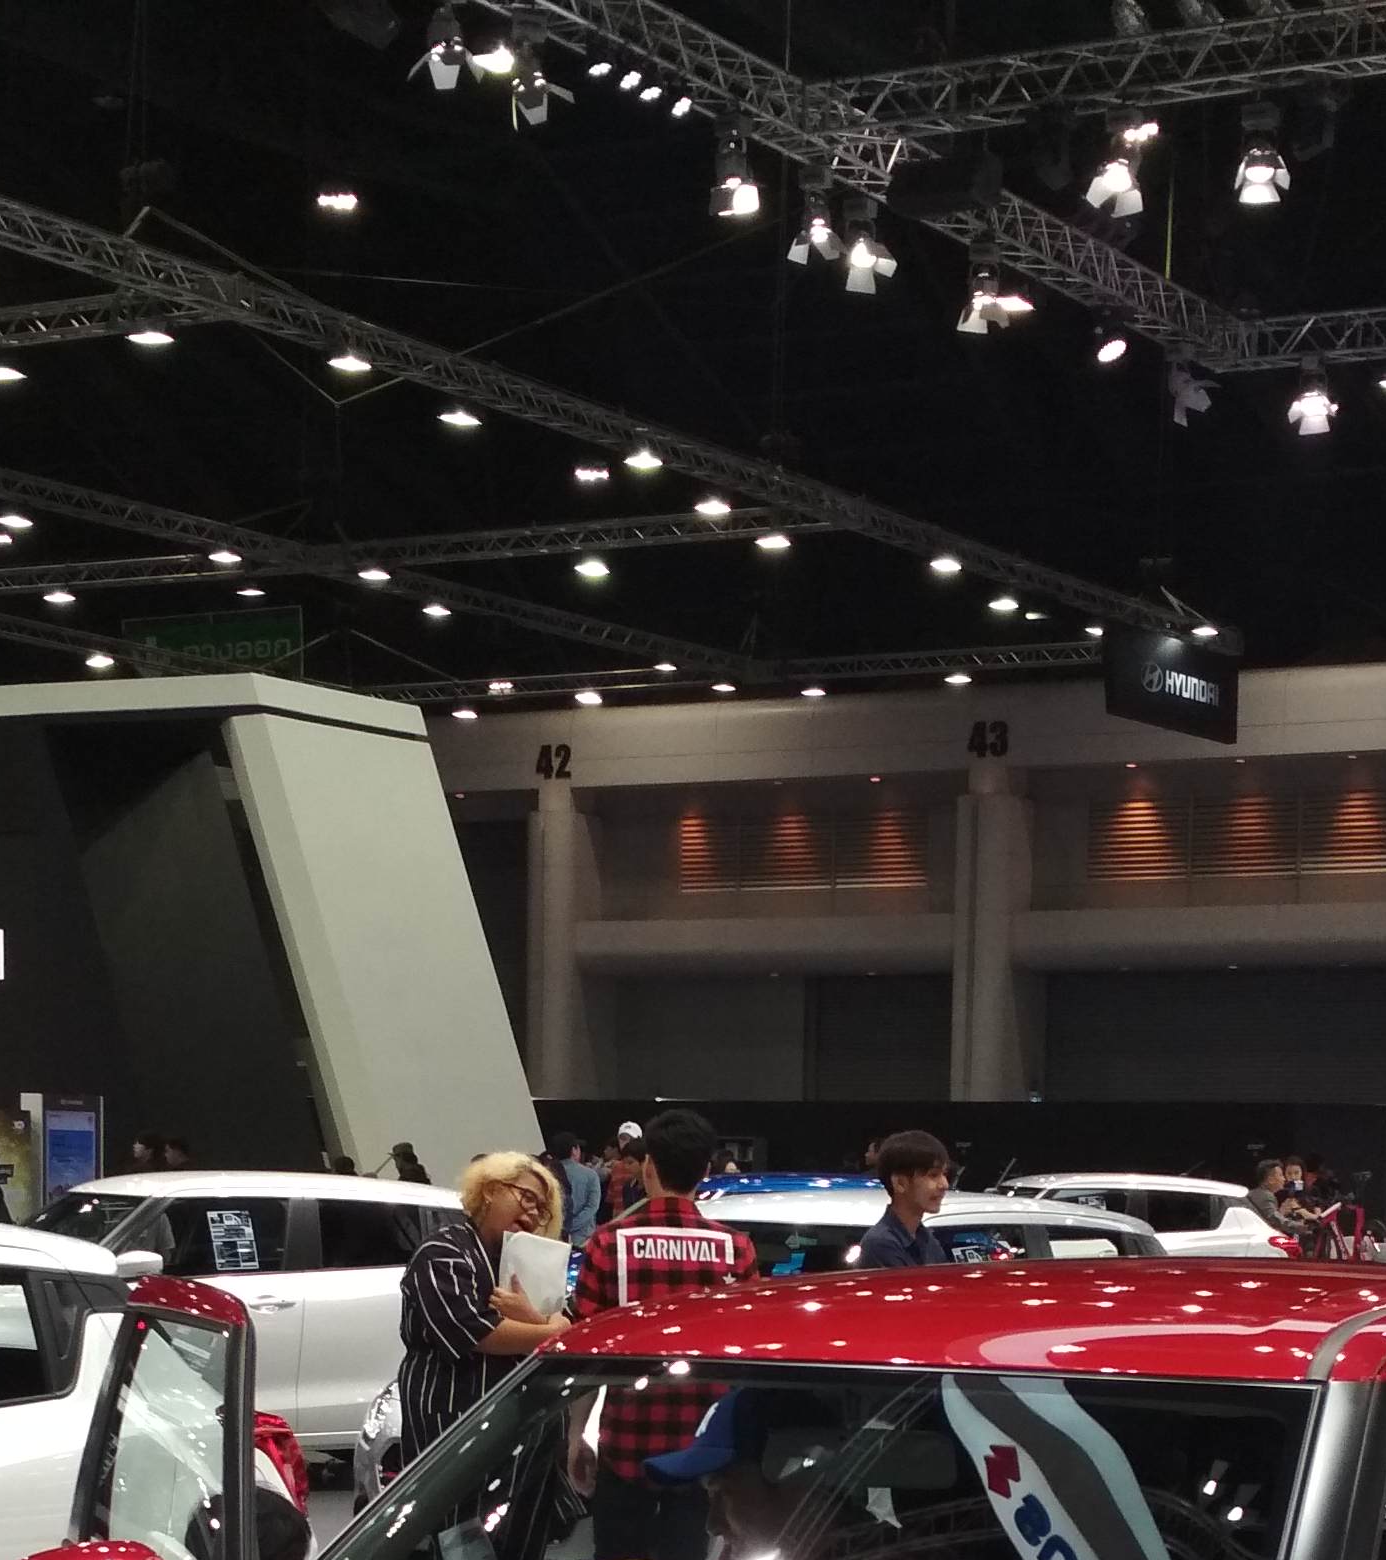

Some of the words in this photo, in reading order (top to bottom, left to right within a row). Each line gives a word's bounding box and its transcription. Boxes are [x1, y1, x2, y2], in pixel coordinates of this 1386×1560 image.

[1165, 669, 1220, 707] HYUNDAI
[967, 720, 1008, 758] 43
[535, 743, 572, 780] 42
[633, 1238, 720, 1263] CARNIVAL
